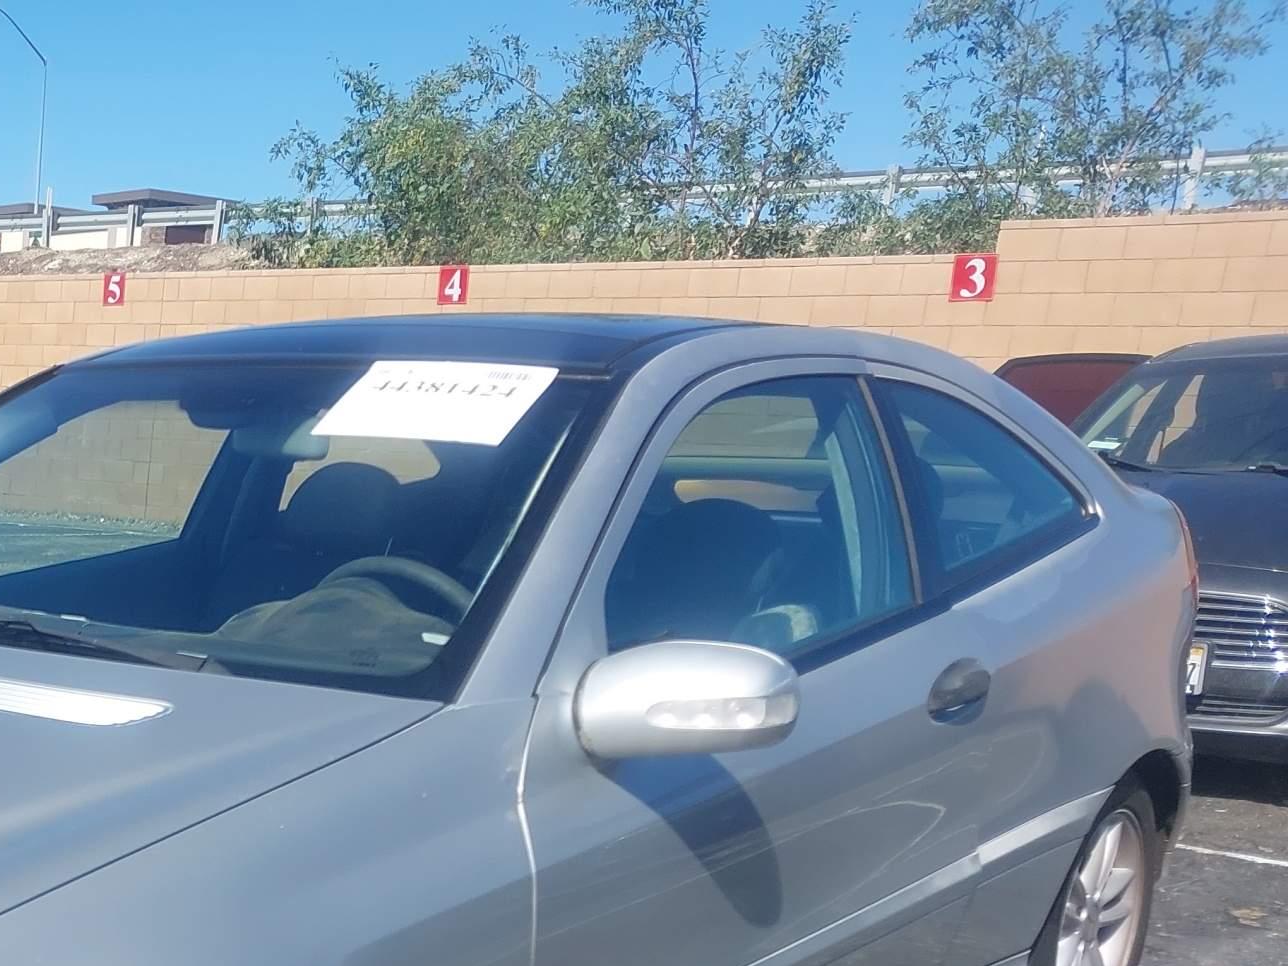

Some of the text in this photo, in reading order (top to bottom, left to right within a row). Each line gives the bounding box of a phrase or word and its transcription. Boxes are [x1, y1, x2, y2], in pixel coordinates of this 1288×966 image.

[107, 275, 121, 304] 5
[444, 269, 462, 302] 4
[959, 258, 986, 298] 3
[371, 379, 518, 398] 44381424
